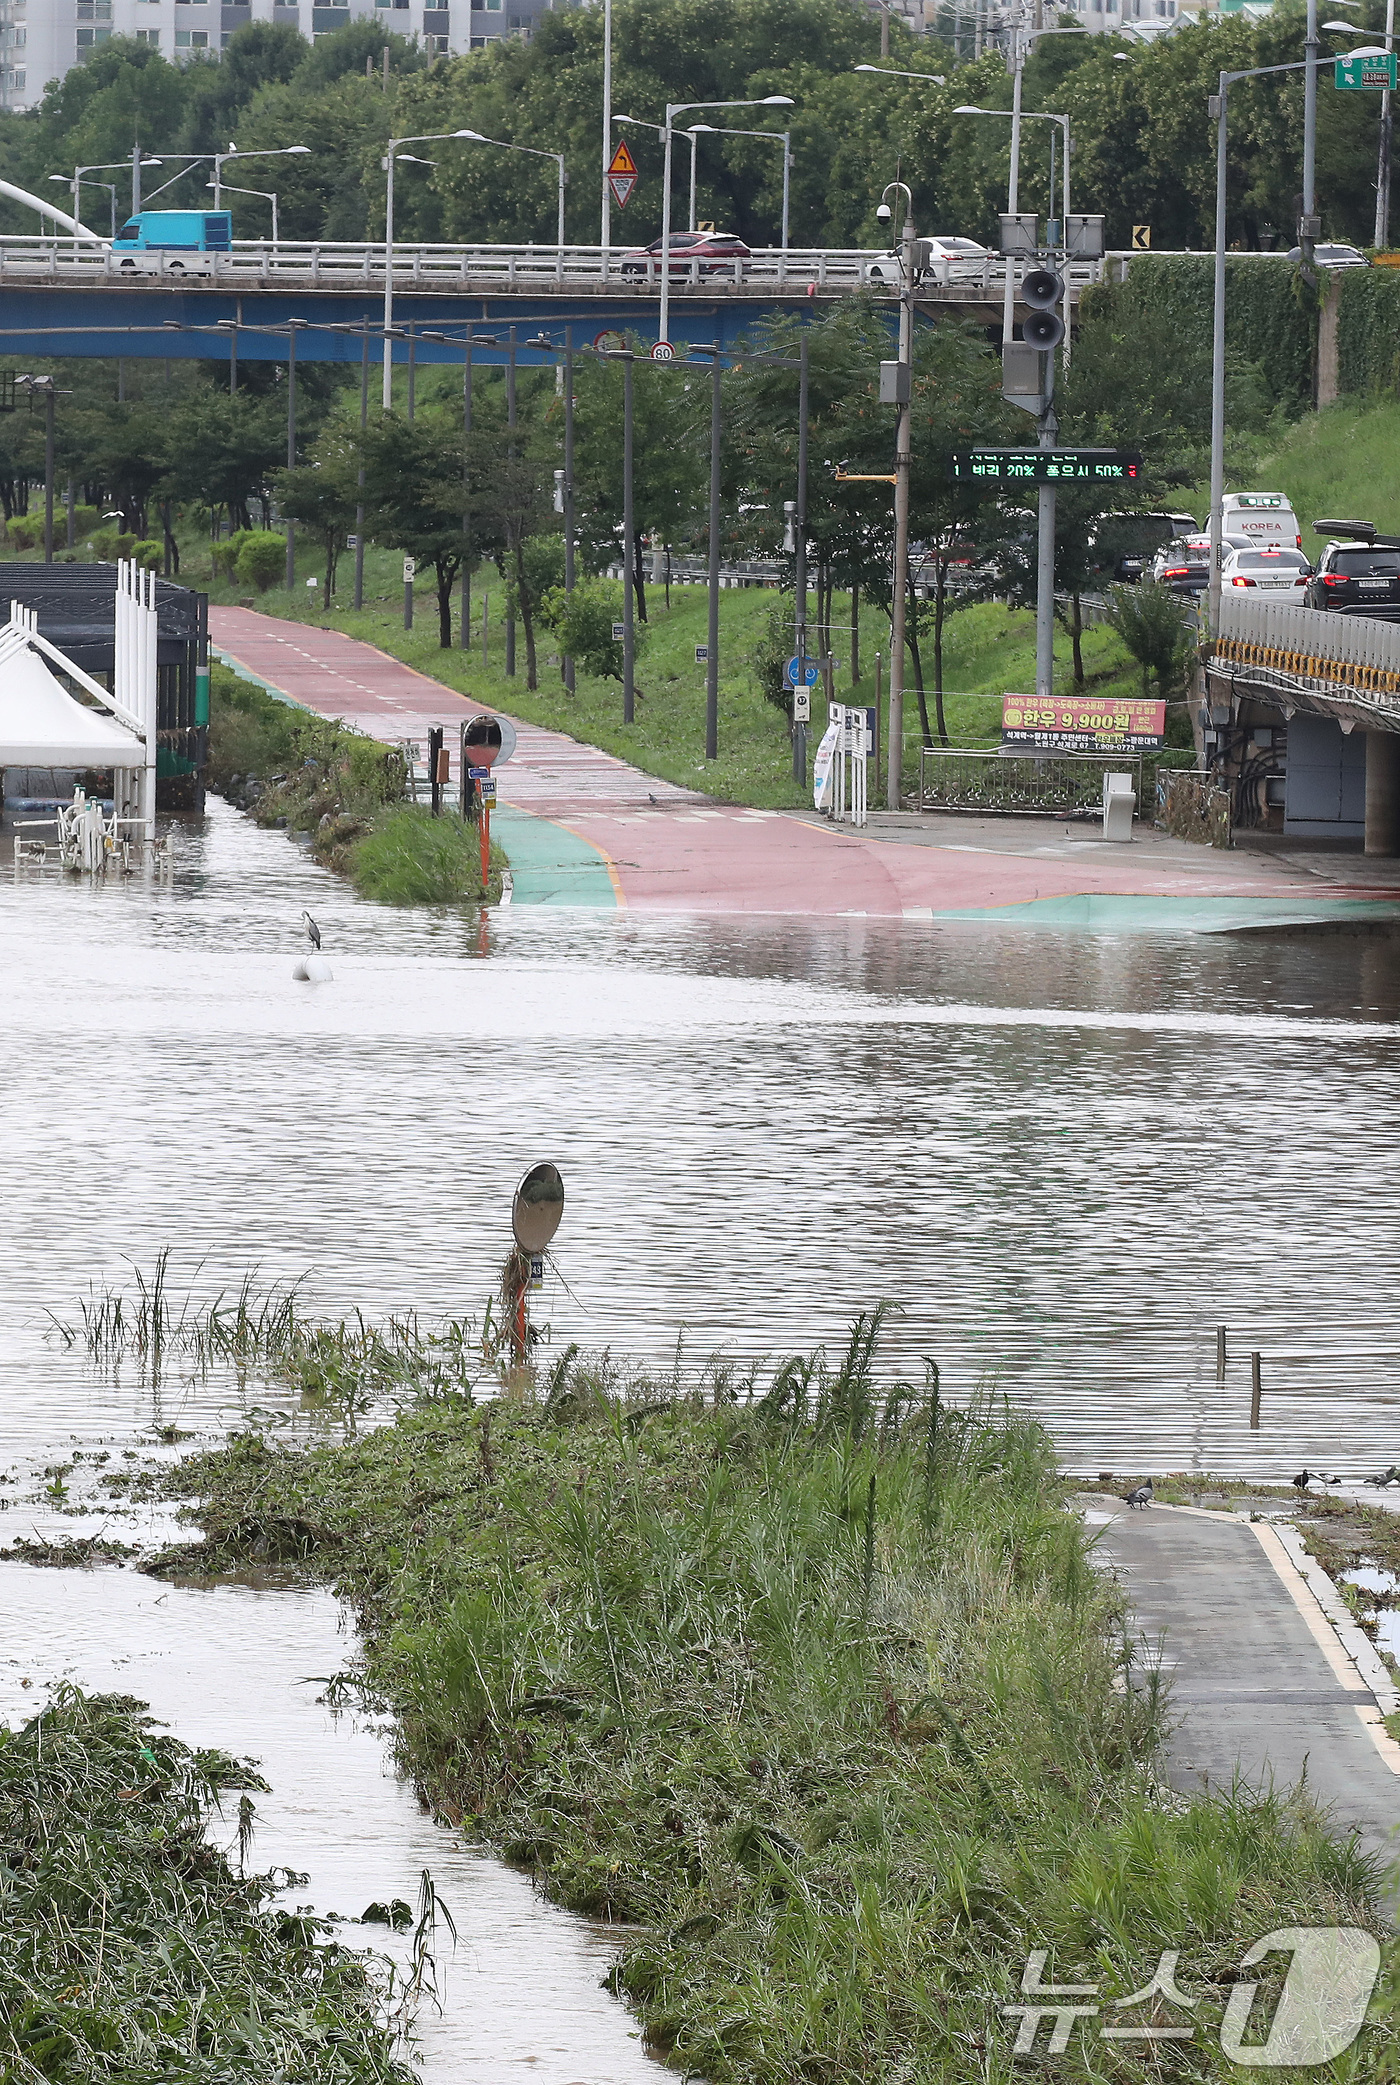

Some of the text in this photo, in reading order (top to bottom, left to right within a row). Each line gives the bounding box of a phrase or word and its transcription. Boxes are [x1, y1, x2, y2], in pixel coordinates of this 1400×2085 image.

[655, 348, 670, 359] 80
[1241, 522, 1282, 531] KOREA
[1023, 709, 1131, 732] 한우 9,900원
